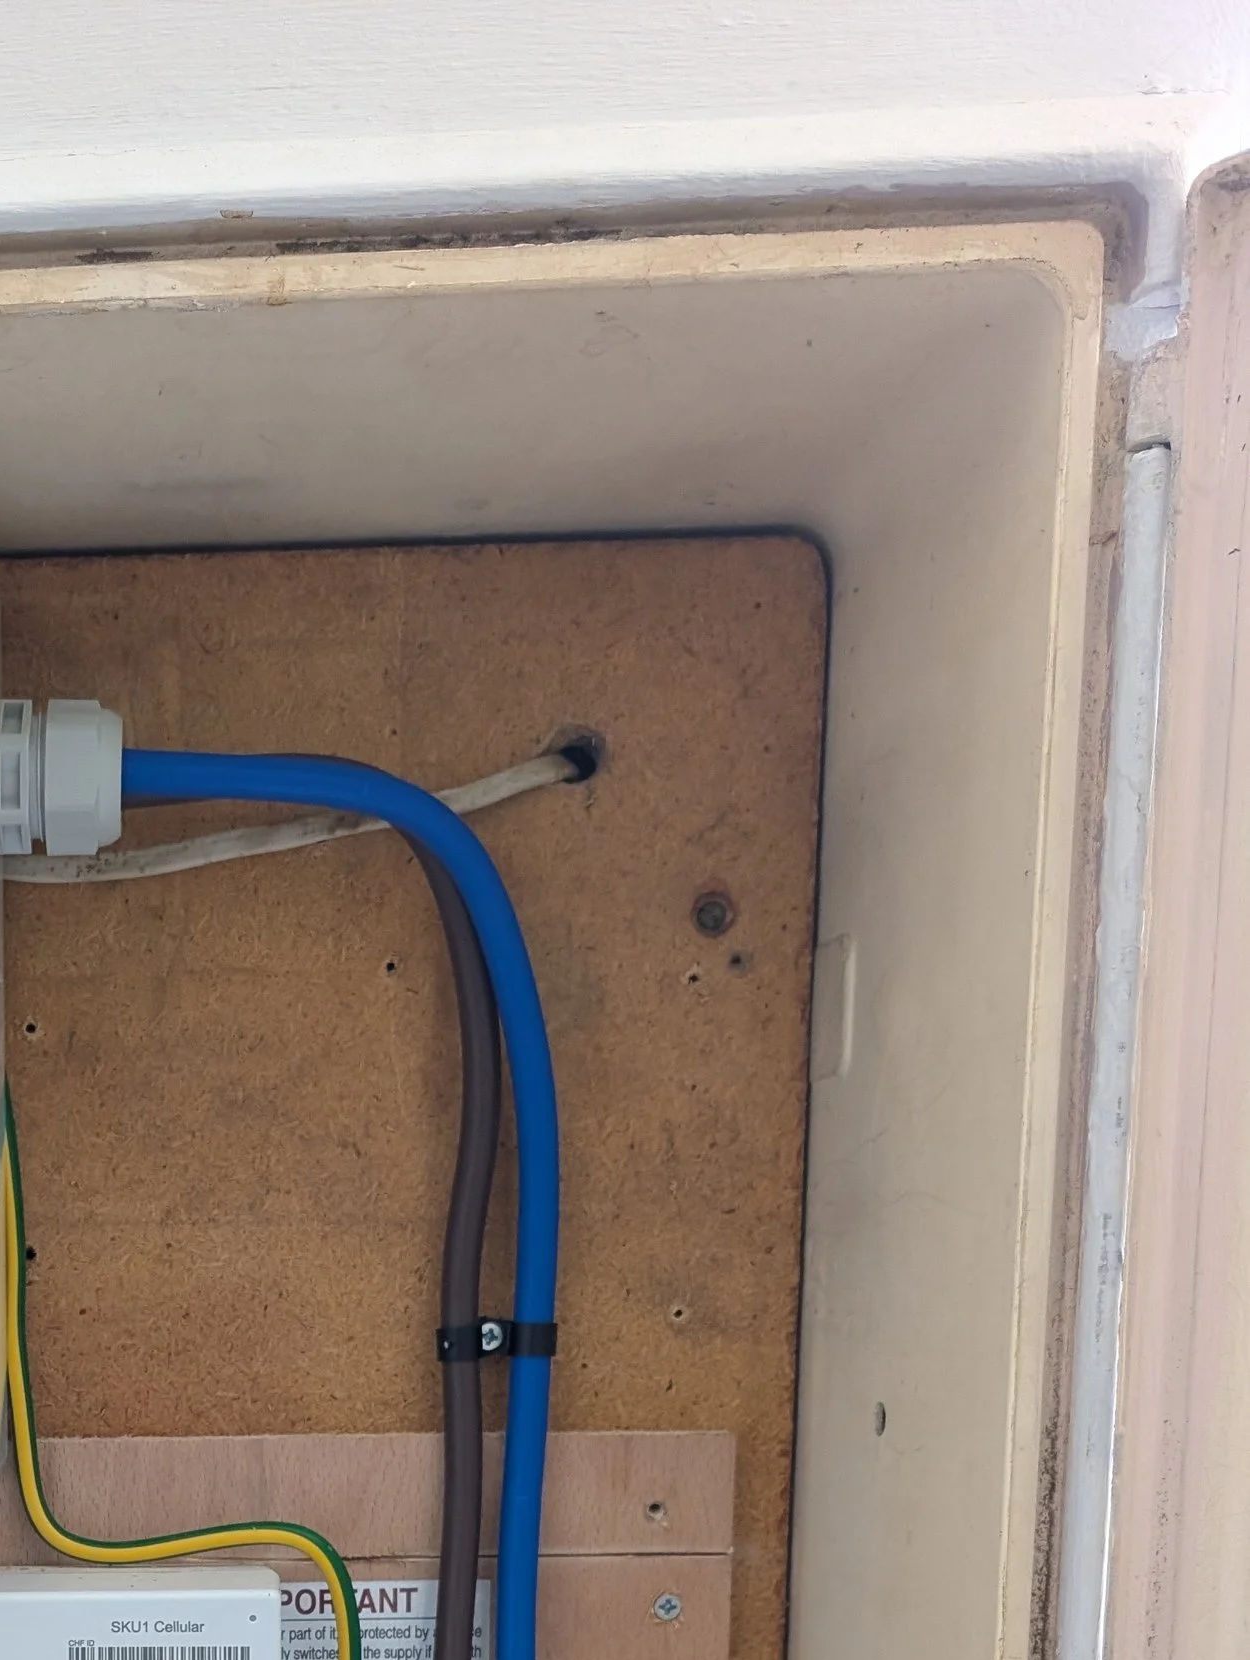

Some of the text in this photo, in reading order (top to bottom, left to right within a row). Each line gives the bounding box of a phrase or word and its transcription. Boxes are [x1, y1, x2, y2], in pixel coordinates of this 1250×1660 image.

[111, 1621, 204, 1633] SKU1 Cellular
[289, 1628, 311, 1643] part
[415, 1626, 428, 1642] by
[364, 1646, 380, 1659] the
